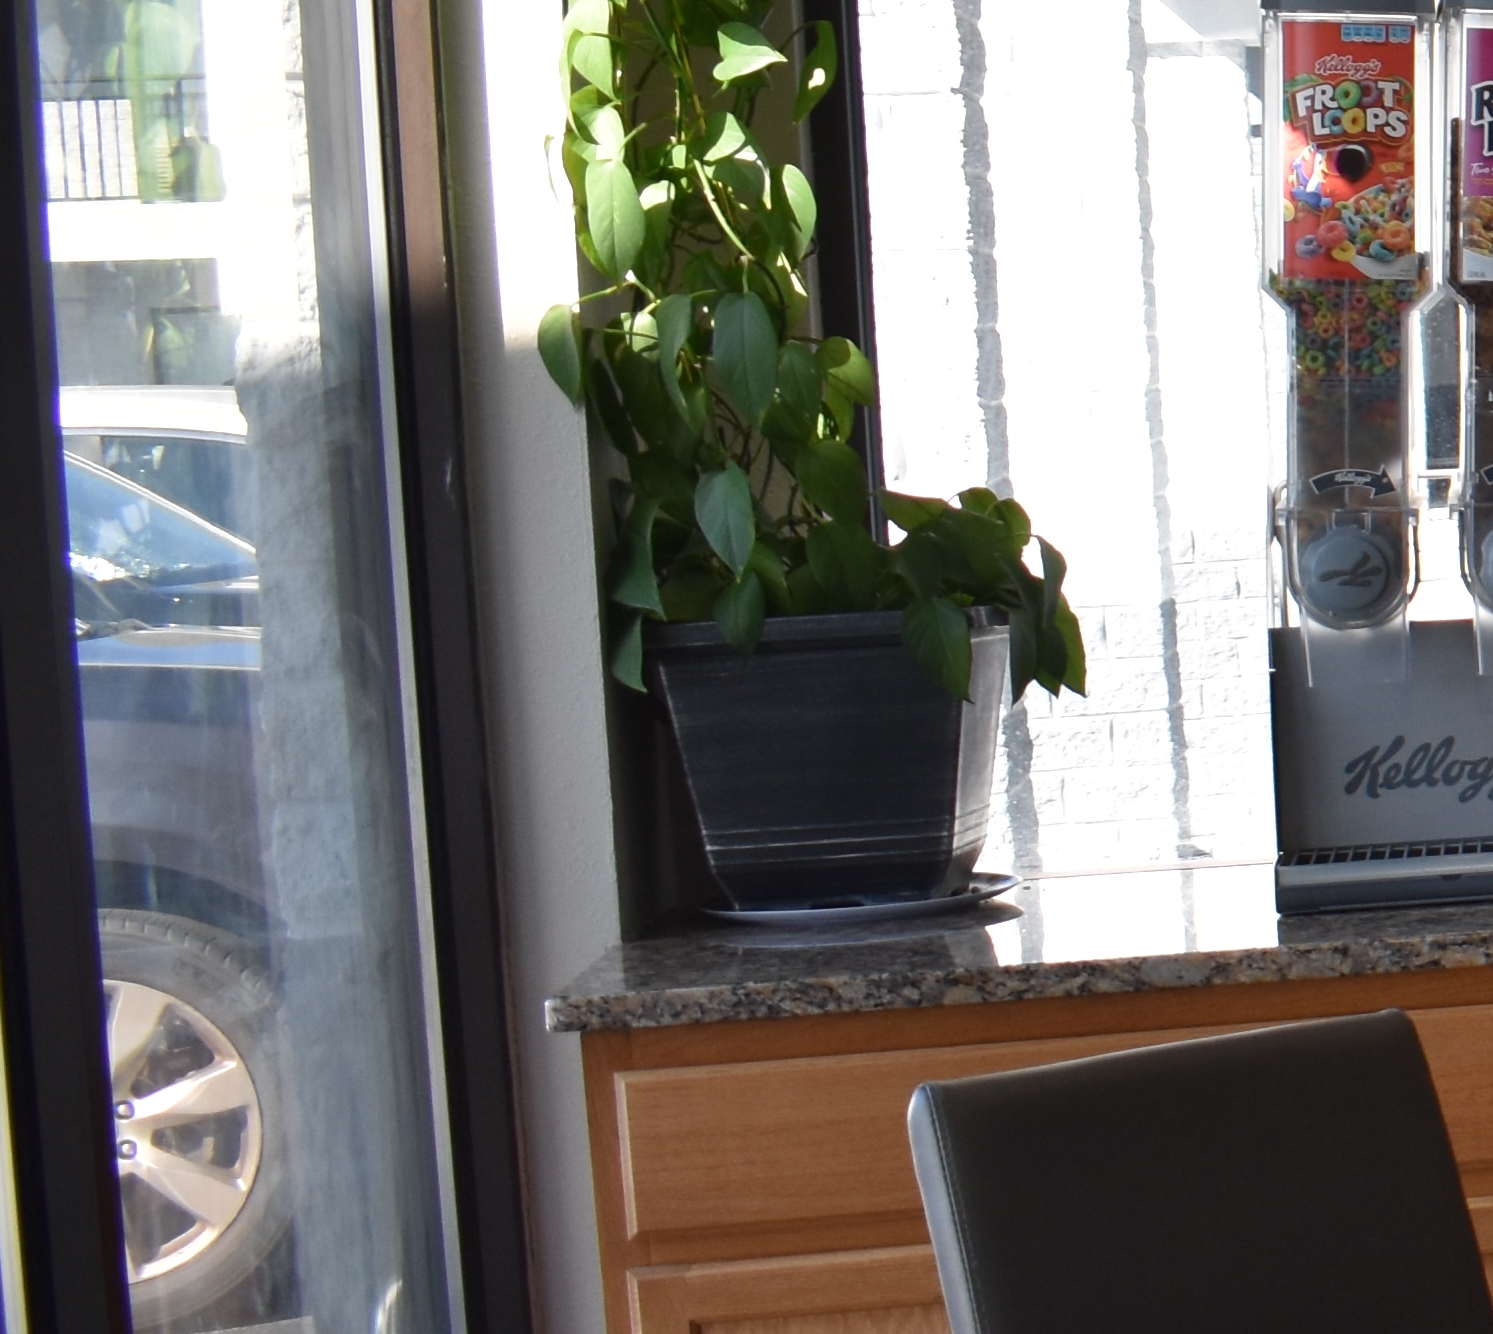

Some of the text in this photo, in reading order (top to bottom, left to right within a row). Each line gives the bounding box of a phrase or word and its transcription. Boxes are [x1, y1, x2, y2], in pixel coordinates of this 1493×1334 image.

[1315, 54, 1381, 79] Kellogg's
[1296, 79, 1400, 117] FROOT
[1313, 107, 1408, 138] LOOPS
